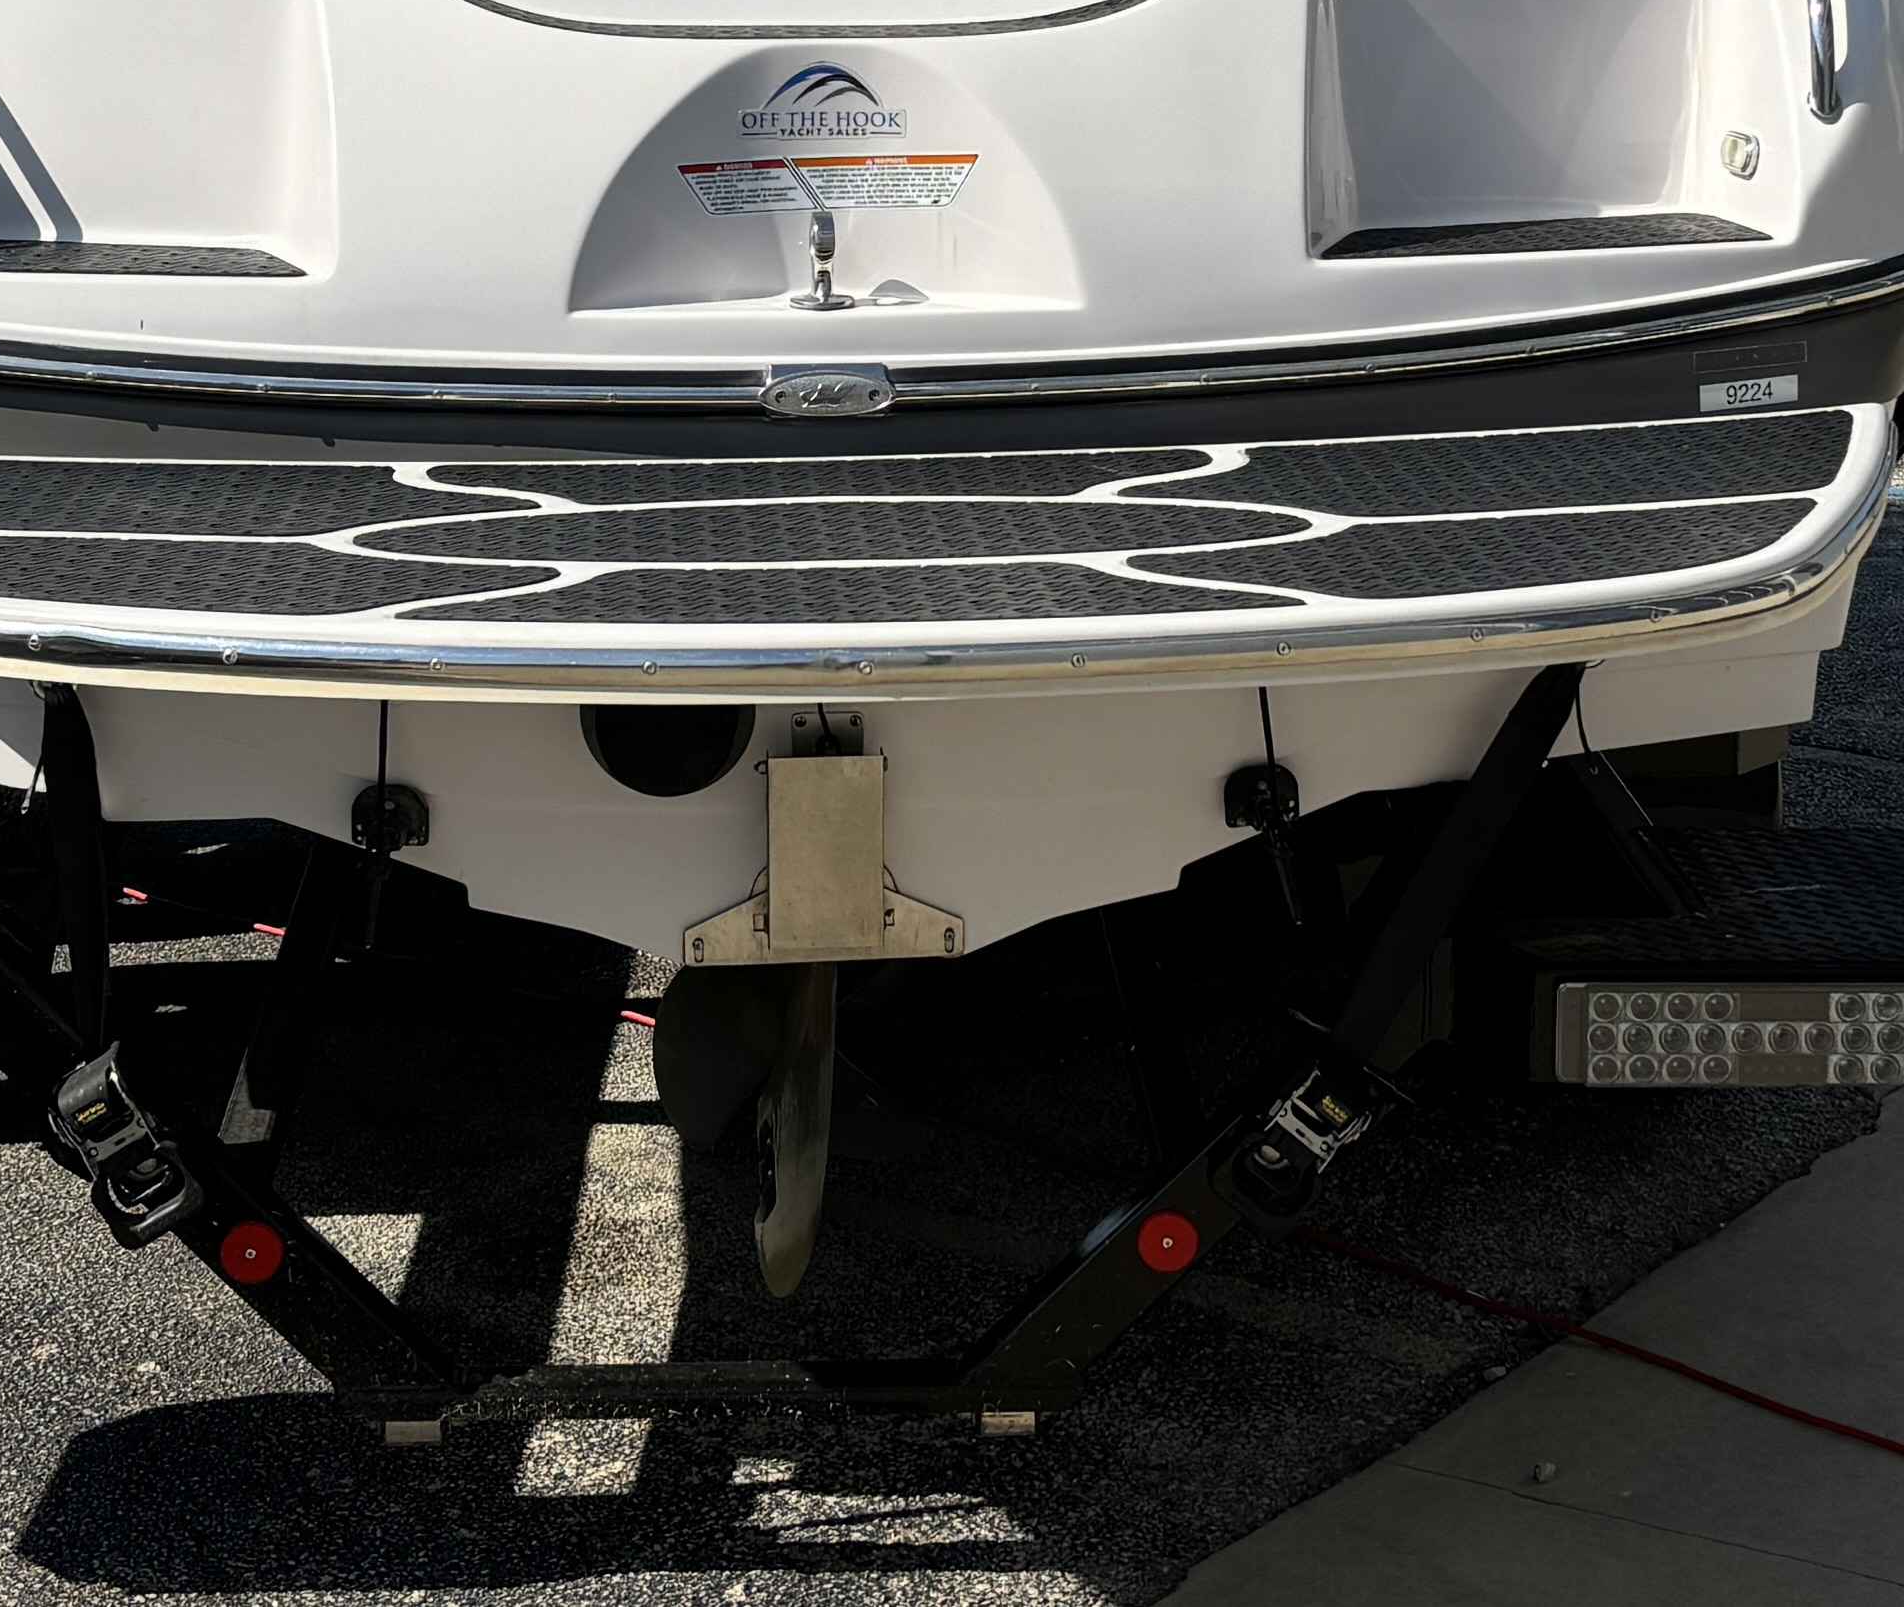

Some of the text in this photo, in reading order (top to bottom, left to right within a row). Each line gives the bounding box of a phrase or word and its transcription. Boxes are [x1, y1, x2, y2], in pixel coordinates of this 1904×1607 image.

[741, 111, 902, 129] OFF THE HOOK
[780, 128, 868, 137] YACHT SALES
[1726, 380, 1774, 405] 9224
